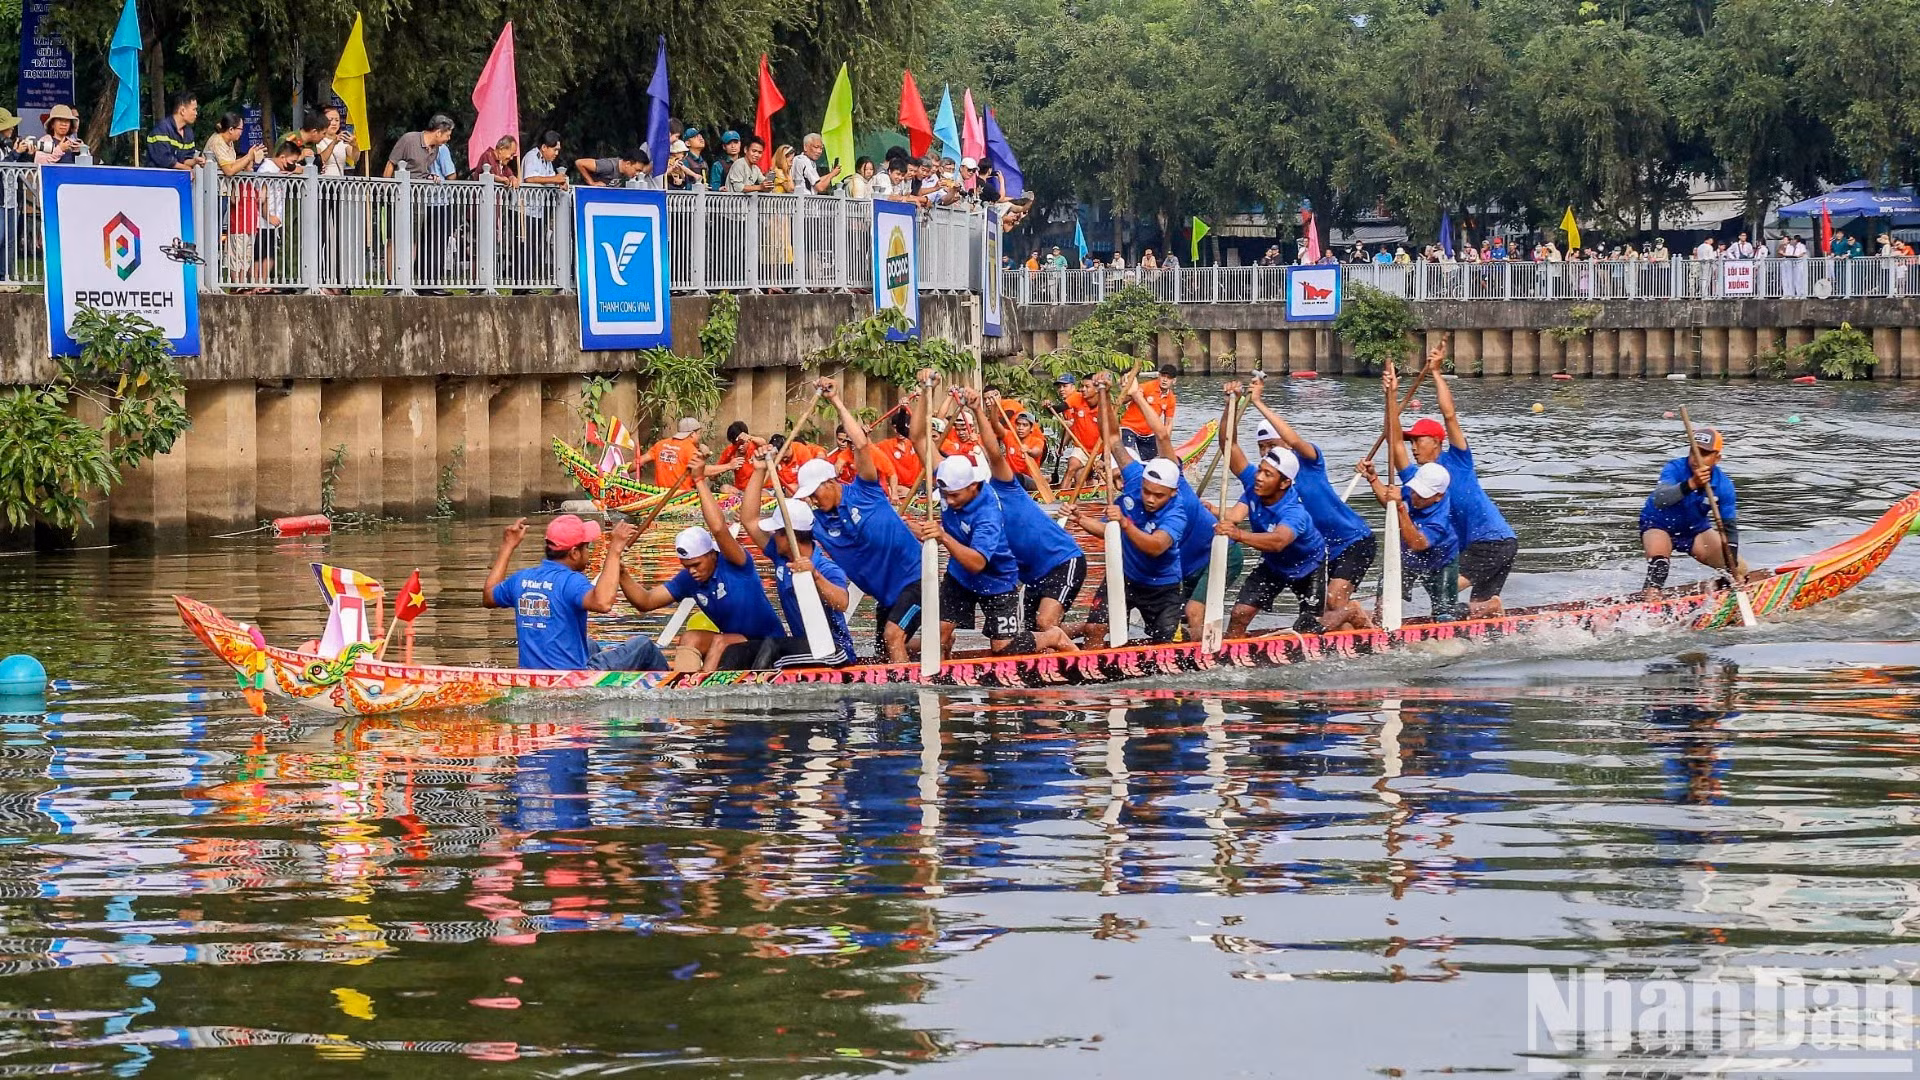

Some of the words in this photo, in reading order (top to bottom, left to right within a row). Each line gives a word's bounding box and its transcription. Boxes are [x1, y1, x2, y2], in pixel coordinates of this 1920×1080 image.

[75, 291, 174, 307] PROWTECH
[599, 301, 620, 313] THANH
[620, 301, 637, 313] CONG
[637, 301, 651, 313] VINA
[997, 615, 1018, 634] 29
